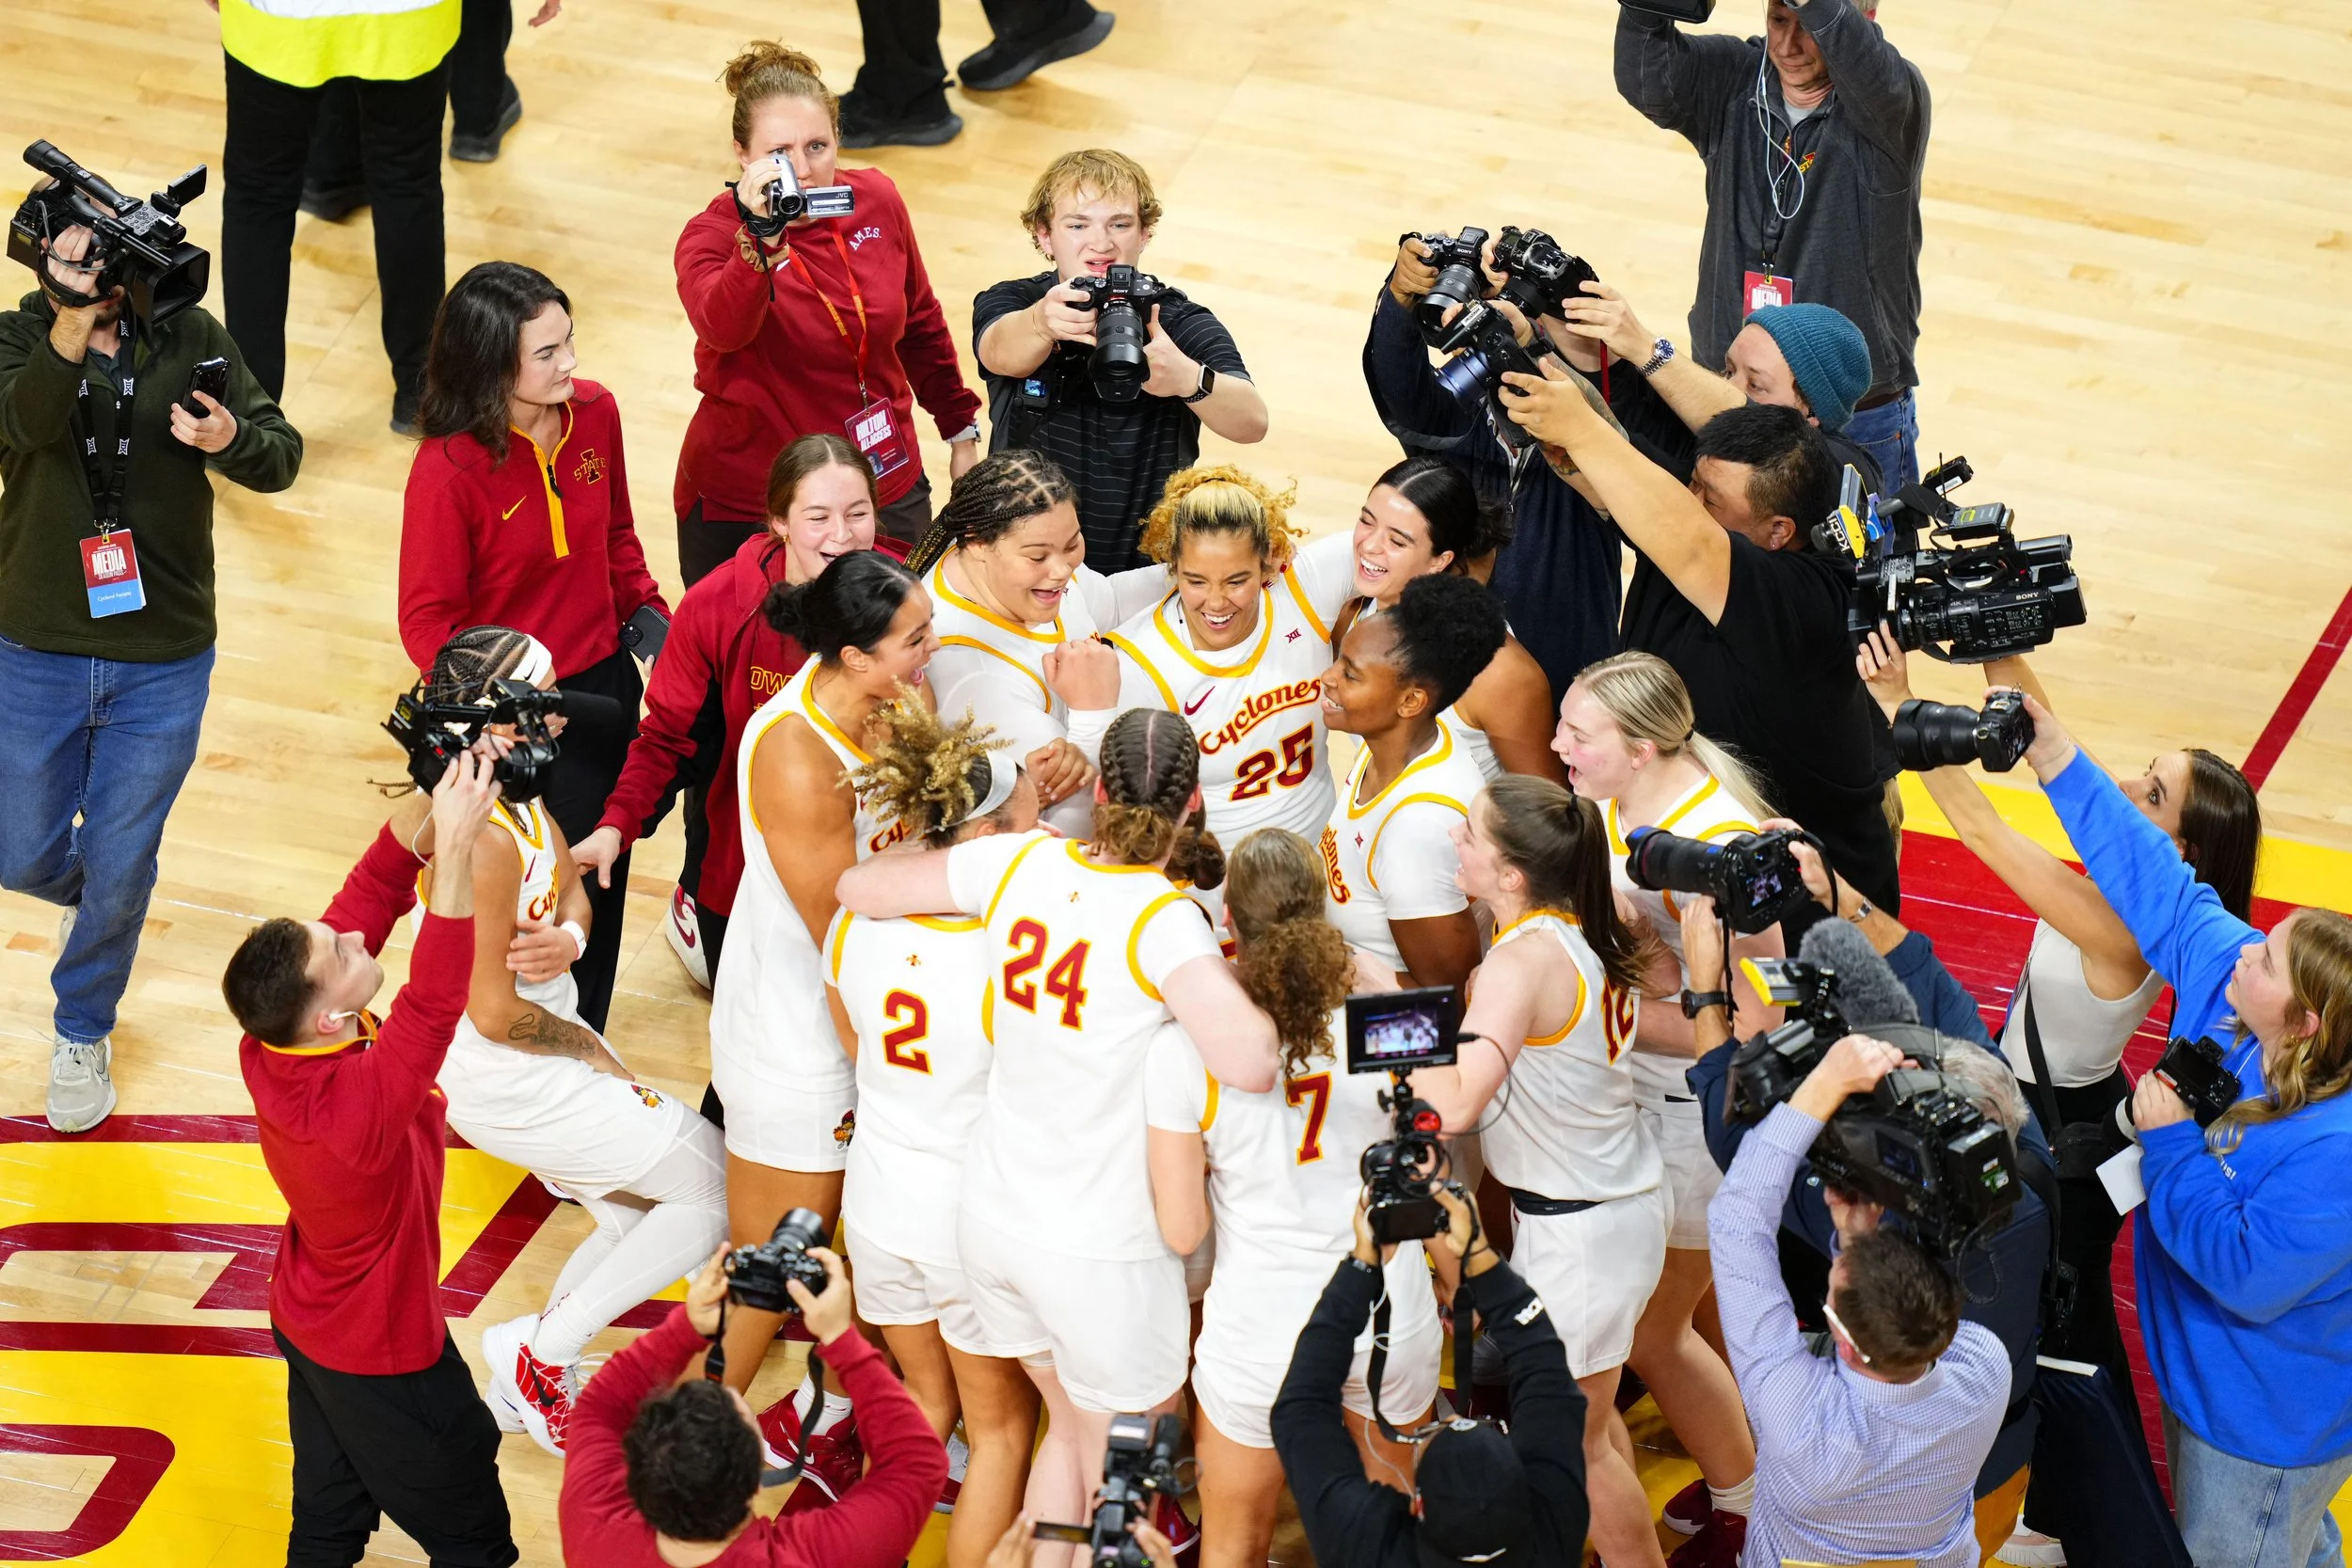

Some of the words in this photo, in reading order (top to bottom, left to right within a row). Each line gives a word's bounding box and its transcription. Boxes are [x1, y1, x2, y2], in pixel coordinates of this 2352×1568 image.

[849, 227, 880, 251] AMES
[1752, 288, 1782, 309] MEDIA
[856, 409, 887, 442] HILTON
[574, 457, 606, 481] STATE
[91, 548, 127, 575] MEDIA
[1829, 518, 1851, 552] KCCI
[1199, 678, 1321, 755] Cyclones
[1229, 721, 1314, 801] 25
[1319, 824, 1351, 905] yclones
[1003, 915, 1091, 1032] 24
[882, 988, 932, 1076] 2
[1283, 1071, 1333, 1165] 7
